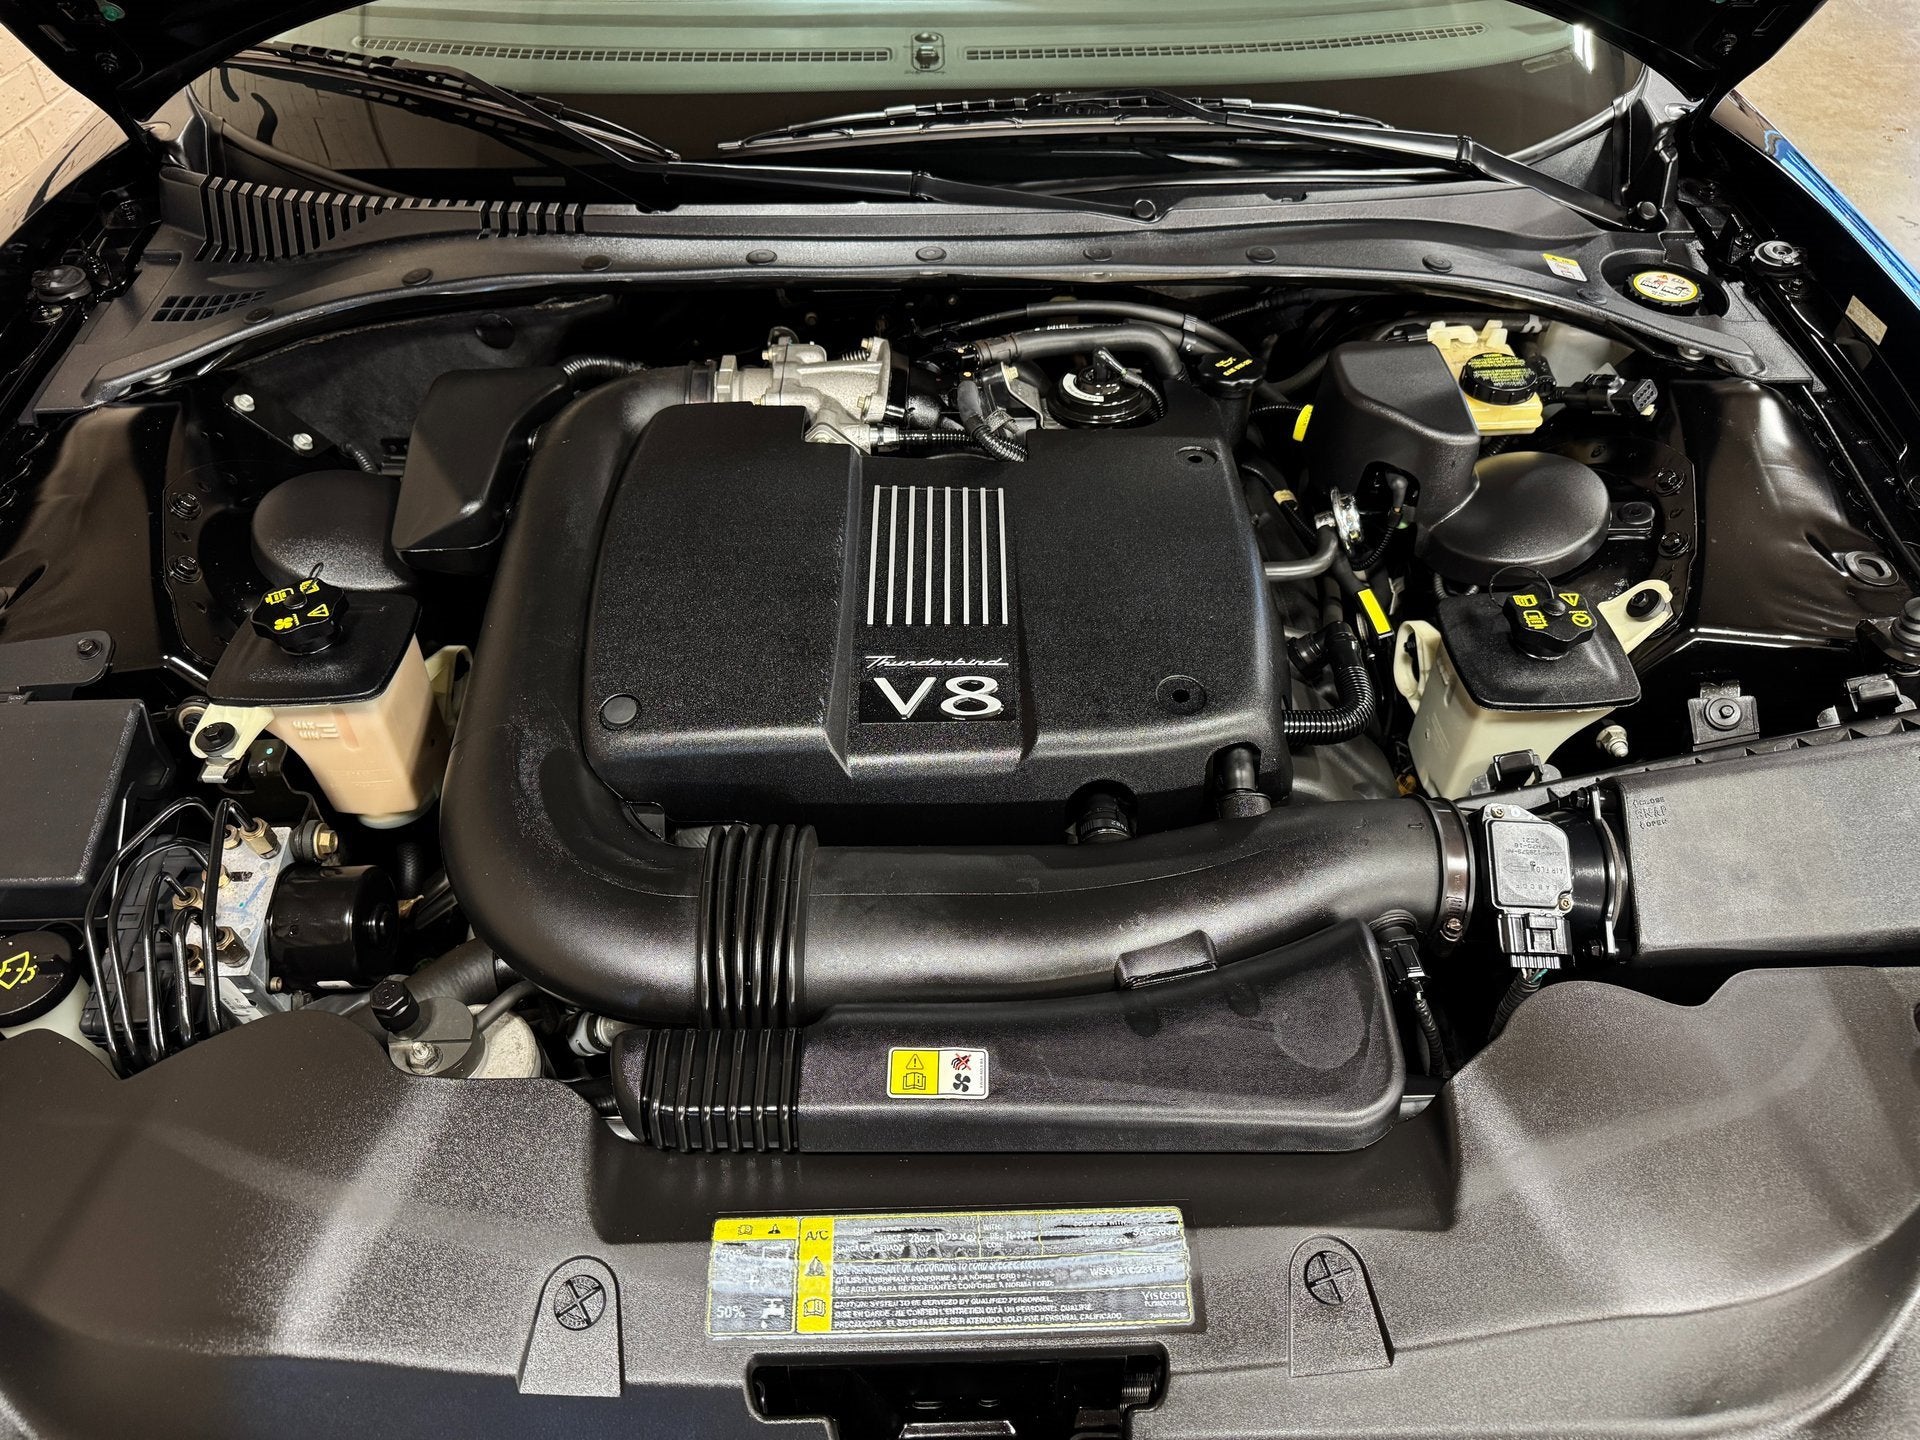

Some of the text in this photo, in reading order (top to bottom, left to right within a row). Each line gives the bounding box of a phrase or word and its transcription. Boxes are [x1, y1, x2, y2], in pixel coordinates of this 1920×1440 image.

[865, 655, 1009, 670] Thunderbird
[873, 676, 1004, 720] V8
[804, 1230, 829, 1242] A/C
[721, 1248, 748, 1260] 50%
[1141, 1291, 1185, 1300] Visteon
[716, 1306, 746, 1318] 50%
[966, 1316, 1001, 1324] ATENDIDO
